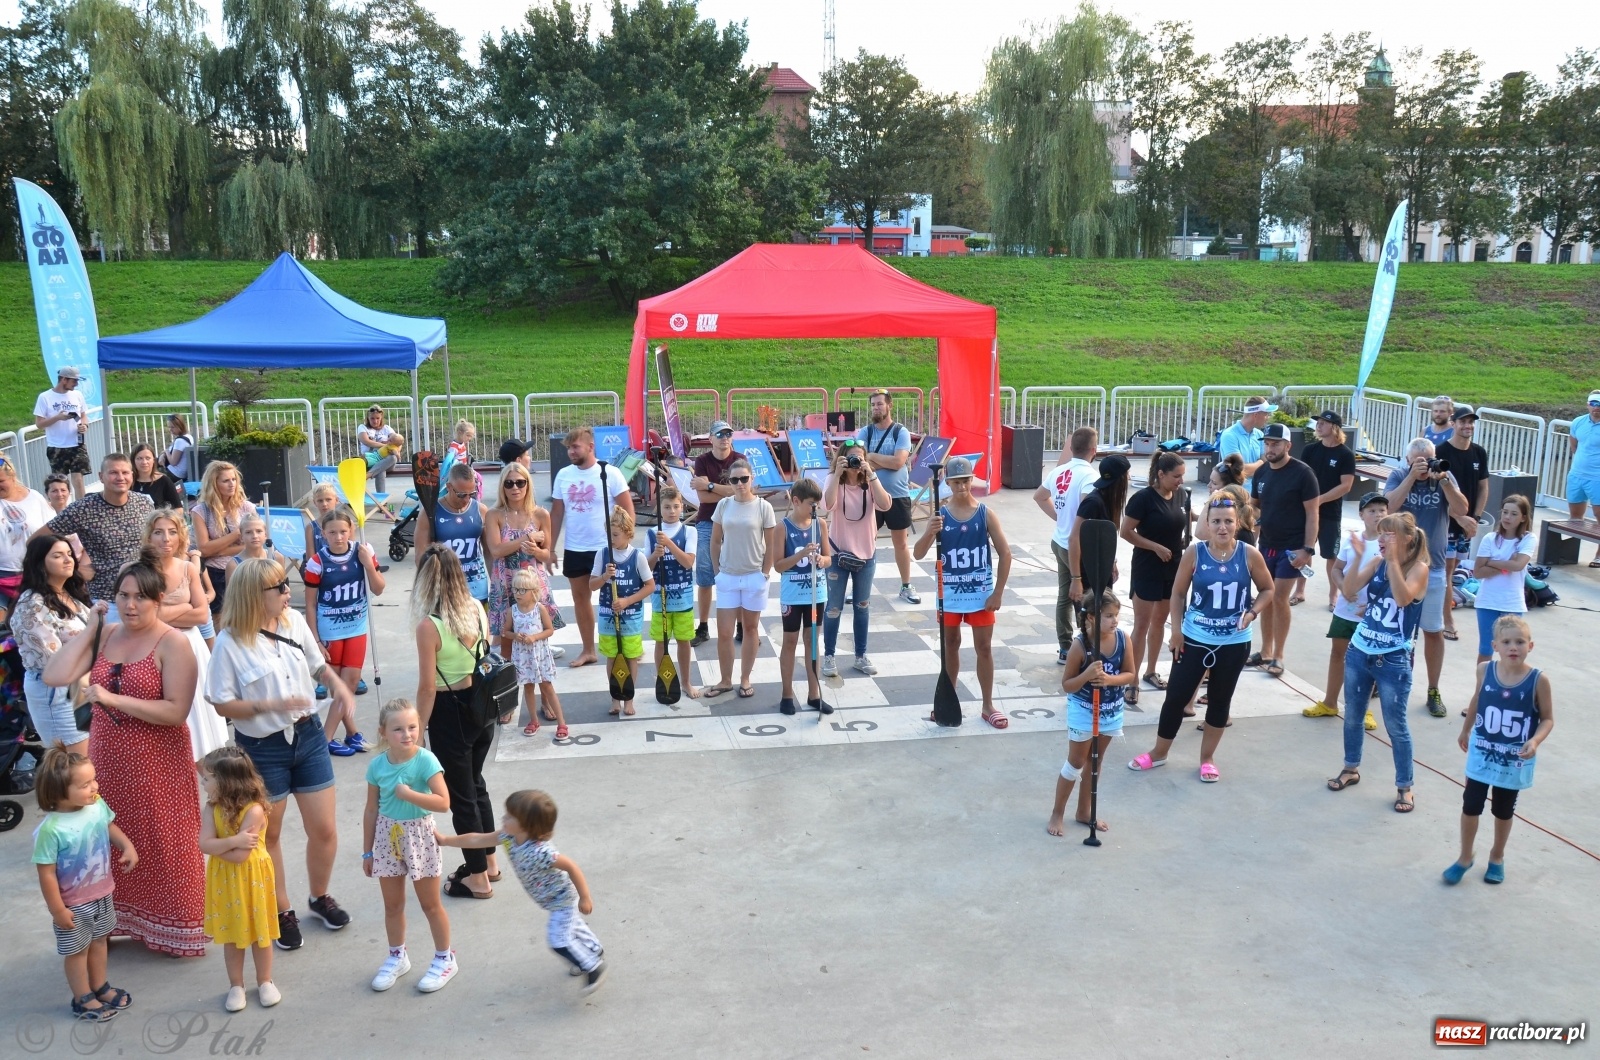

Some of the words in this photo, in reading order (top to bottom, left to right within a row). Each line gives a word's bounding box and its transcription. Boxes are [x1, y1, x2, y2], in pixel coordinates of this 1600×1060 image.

[947, 547, 980, 569] 131
[333, 581, 359, 602] 111
[1207, 582, 1238, 609] 11
[1009, 707, 1056, 721] 3
[1484, 705, 1524, 738] 05
[645, 730, 693, 742] 7
[1494, 743, 1509, 754] SUP
